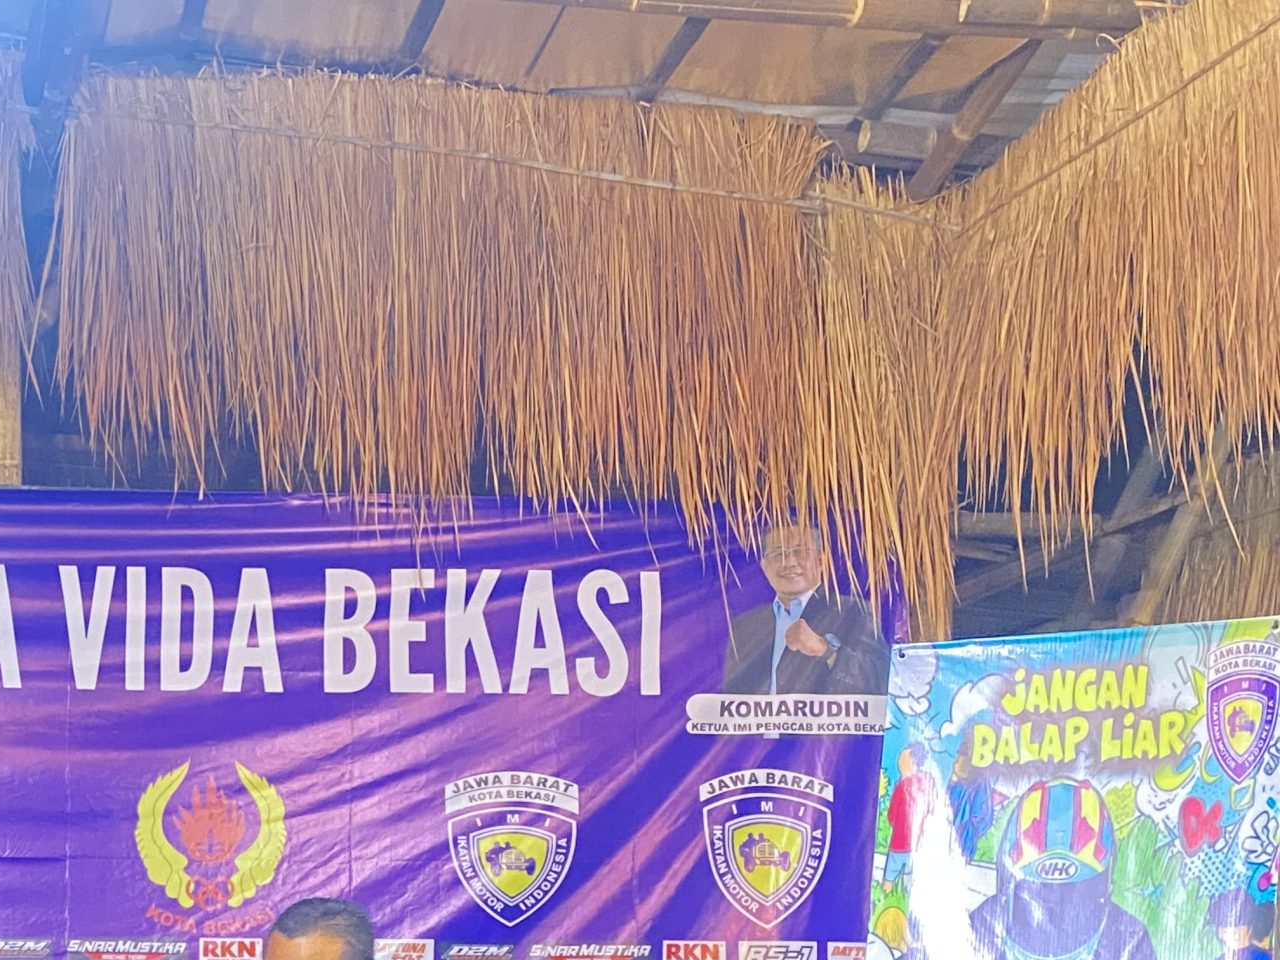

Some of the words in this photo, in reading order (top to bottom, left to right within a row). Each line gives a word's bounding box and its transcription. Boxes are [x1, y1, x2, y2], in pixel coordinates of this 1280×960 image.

[57, 563, 285, 694] VIDA
[323, 567, 662, 697] BEKASI
[1213, 645, 1244, 664] JAWA
[1244, 643, 1279, 657] BARAT
[1214, 660, 1241, 676] KOTA
[1242, 658, 1277, 671] BEKASI
[719, 699, 870, 718] KOMARUDIN
[691, 722, 730, 733] KETUA
[732, 722, 753, 733] IMI
[763, 722, 813, 733] PENGCAB
[817, 723, 846, 733] KOTA
[972, 716, 1090, 768] BALAP
[451, 774, 504, 795] JAWA
[510, 774, 574, 794] BARAT
[706, 772, 760, 795] JAWA
[765, 772, 830, 796] BARAT
[468, 789, 503, 804] KOTA
[507, 789, 557, 804] BEKASI
[456, 835, 476, 878] IKATAN
[470, 878, 505, 913] MOTOR
[519, 837, 569, 912] INDONESIA
[712, 825, 730, 875] IKATAN
[722, 873, 760, 913] MOTOR
[775, 828, 824, 911] INDONESIA
[1038, 861, 1074, 877] NHK
[202, 940, 257, 957] RKN
[448, 945, 510, 955] D2M
[666, 943, 720, 960] RKN
